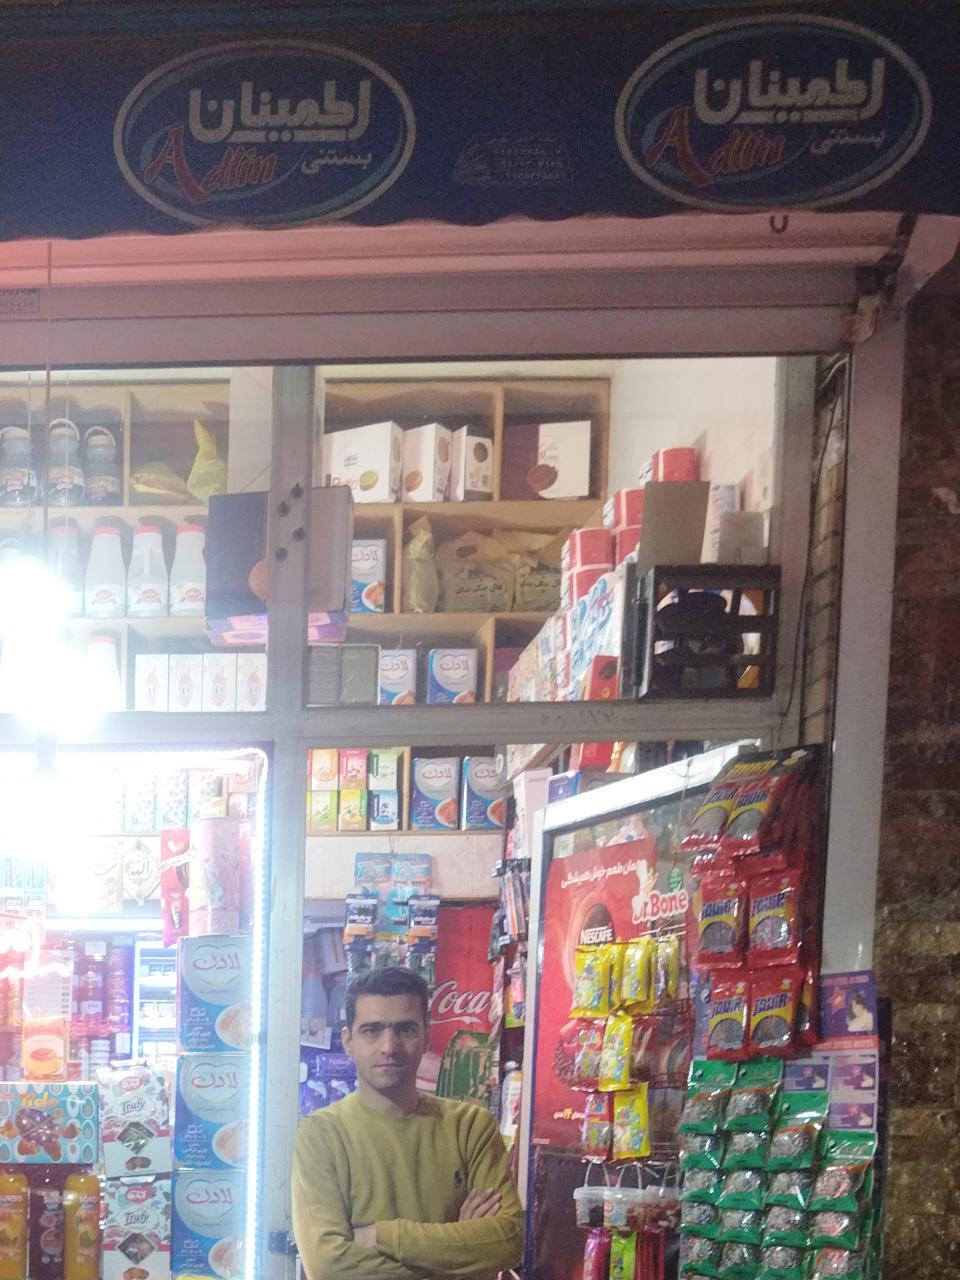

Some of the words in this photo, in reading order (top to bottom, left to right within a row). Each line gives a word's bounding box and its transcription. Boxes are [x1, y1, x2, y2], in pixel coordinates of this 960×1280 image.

[694, 58, 886, 126] اطمینان
[189, 80, 372, 144] اطمینان
[811, 129, 887, 155] بستنی
[301, 149, 372, 175] بستنی
[191, 952, 241, 972] لادن
[191, 1070, 239, 1089] لادن
[186, 1188, 234, 1205] لادن
